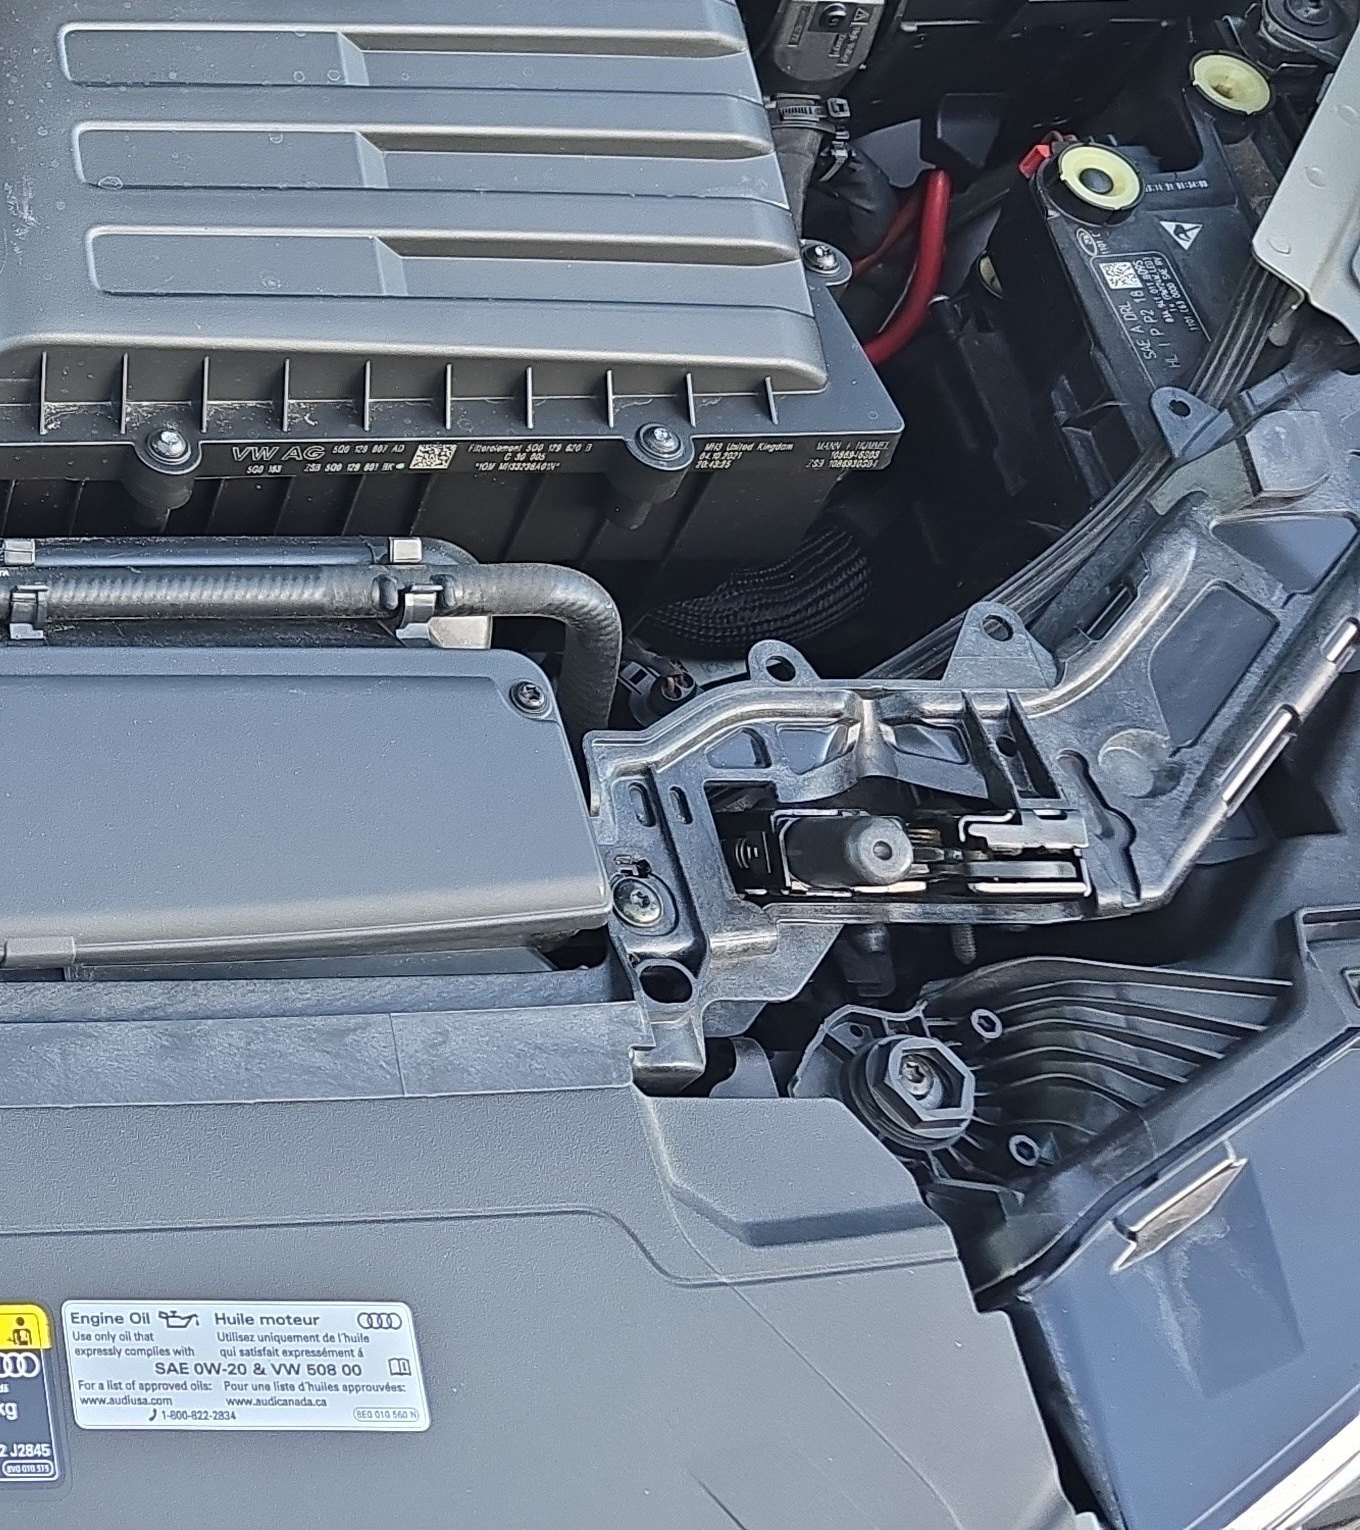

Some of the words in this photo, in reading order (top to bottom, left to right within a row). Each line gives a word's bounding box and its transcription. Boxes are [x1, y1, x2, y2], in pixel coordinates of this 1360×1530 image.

[1130, 290, 1146, 304] 18
[1140, 309, 1158, 324] P2
[1131, 326, 1144, 334] A
[1150, 328, 1165, 337] P
[1137, 339, 1157, 360] SAE
[1165, 355, 1181, 368] HL
[232, 446, 280, 461] VW
[281, 445, 325, 461] AG
[726, 442, 753, 451] United
[757, 442, 794, 452] Kingdom
[71, 1312, 124, 1326] Engine
[130, 1312, 150, 1325] Oil
[214, 1312, 254, 1326] Huile
[260, 1313, 320, 1326] moteur
[72, 1332, 91, 1341] Use
[95, 1331, 116, 1343] only
[119, 1331, 132, 1341] oil
[134, 1331, 154, 1341] that
[217, 1332, 255, 1342] Utilisez
[257, 1332, 320, 1345] uniquement
[323, 1332, 335, 1343] de
[75, 1347, 121, 1358] expressly
[125, 1347, 170, 1358] complies
[172, 1347, 194, 1356] with
[220, 1347, 236, 1358] qui
[239, 1347, 279, 1357] satisfait
[282, 1347, 355, 1359] expressément
[155, 1362, 190, 1375] SAE
[194, 1363, 246, 1375] 0W-20
[253, 1364, 267, 1376] &
[270, 1363, 300, 1375] VW
[307, 1364, 337, 1376] 508
[342, 1364, 362, 1376] 00
[79, 1380, 95, 1390] For
[107, 1380, 123, 1390] list
[125, 1380, 135, 1390] of
[139, 1380, 187, 1392] approved
[190, 1381, 212, 1391] oils:
[224, 1381, 248, 1391] Pour
[251, 1383, 270, 1391] une
[274, 1381, 295, 1391] liste
[299, 1381, 339, 1392] d'huiles
[342, 1382, 406, 1394] approuvées:
[80, 1396, 173, 1405] www.audiusa.com
[226, 1397, 327, 1407] www.audicanada.ca
[161, 1410, 236, 1420] 1-800-822-2834
[375, 1411, 390, 1419] 010
[393, 1411, 408, 1419] 560
[9, 1443, 51, 1458] J2845
